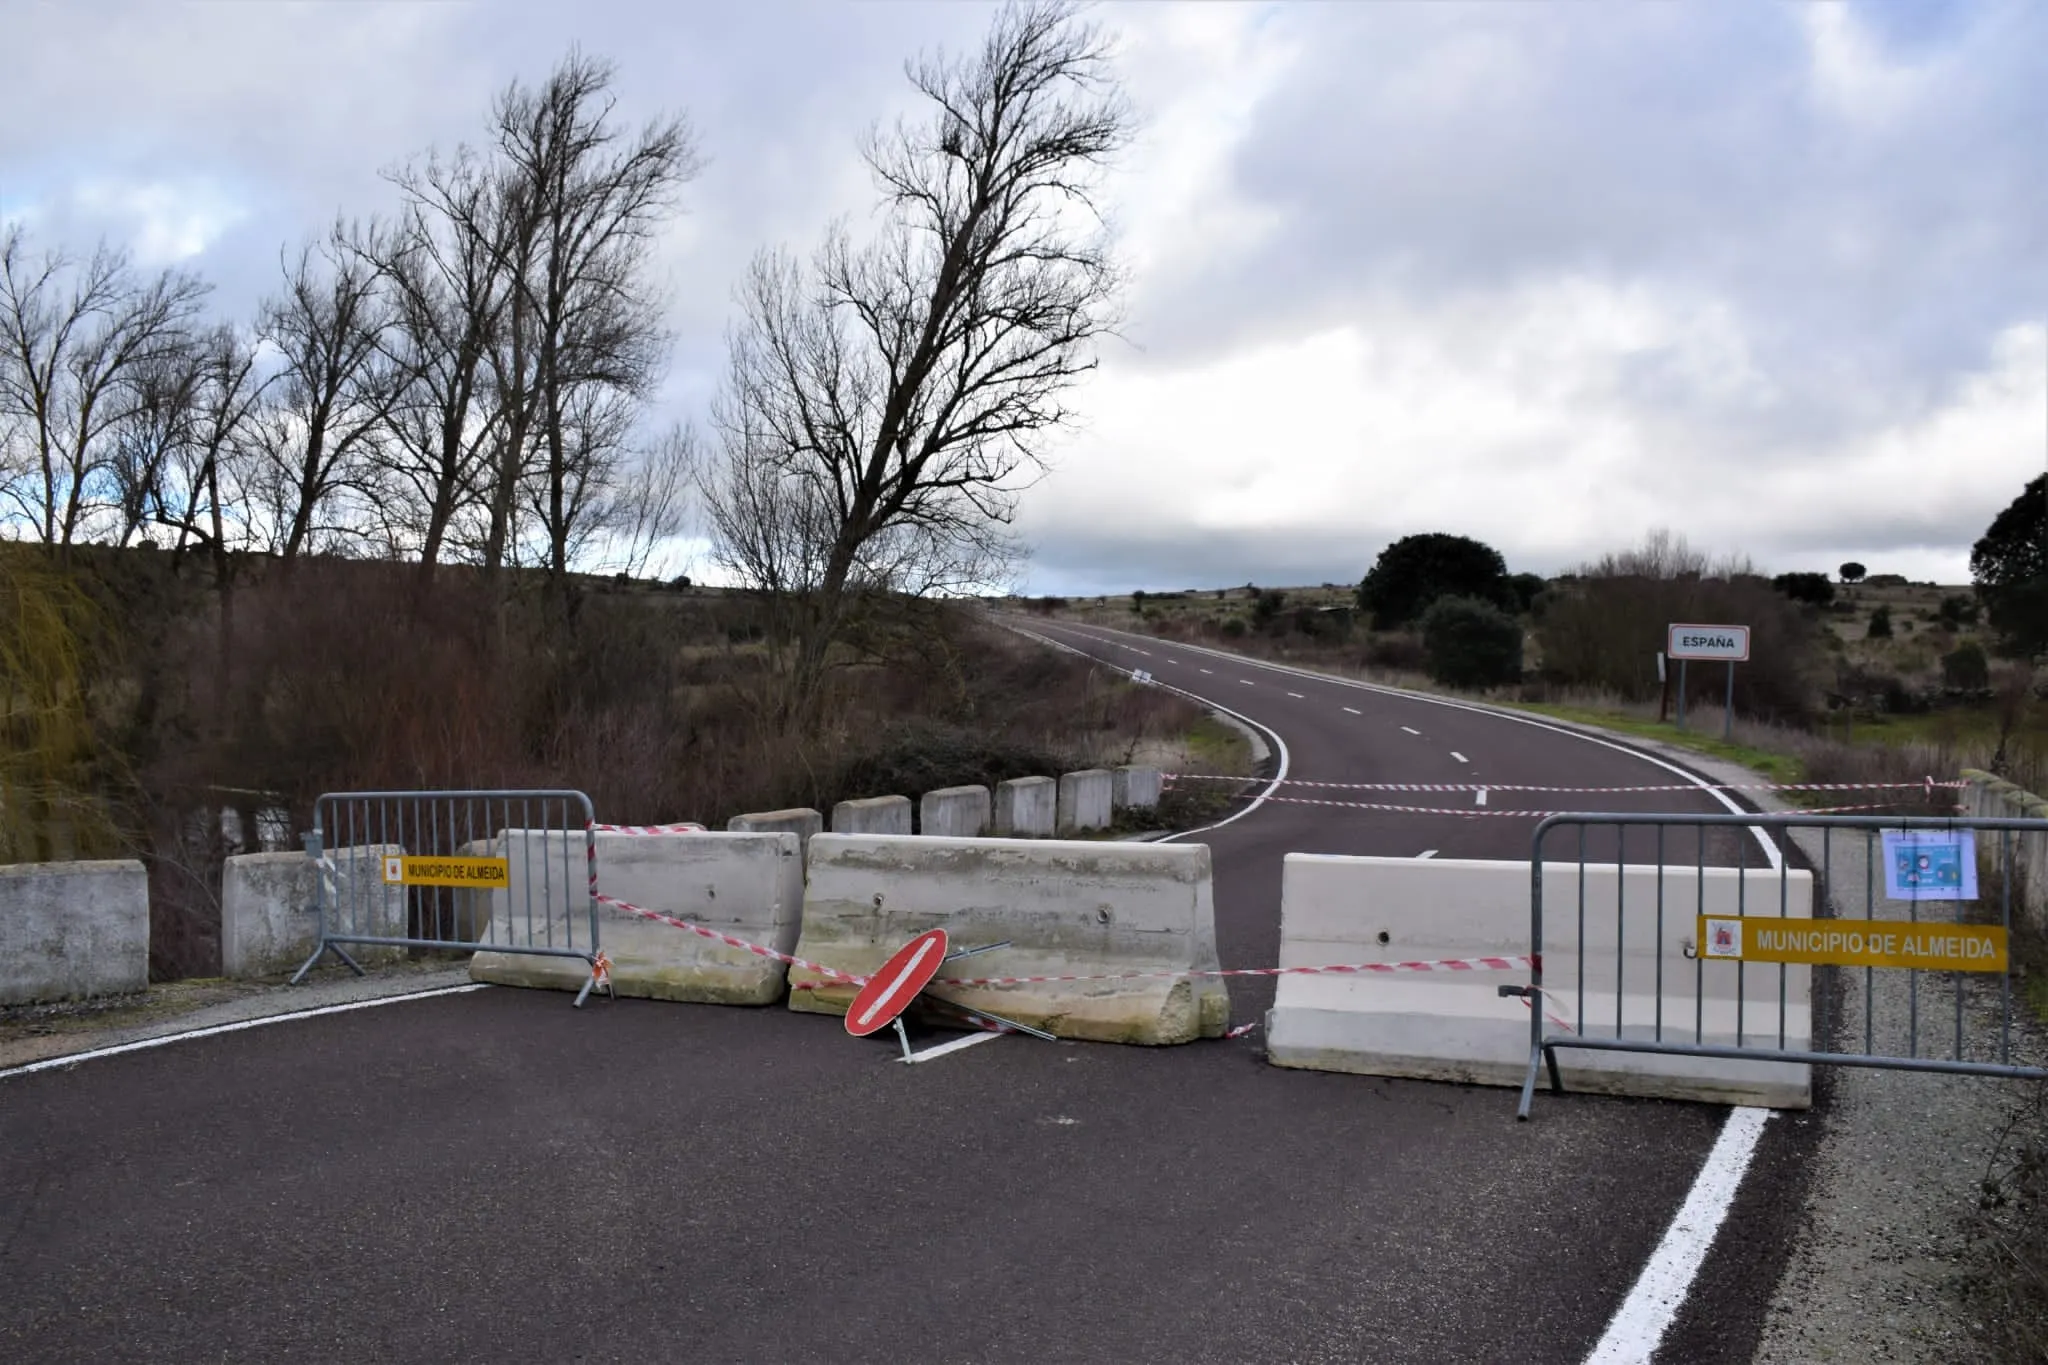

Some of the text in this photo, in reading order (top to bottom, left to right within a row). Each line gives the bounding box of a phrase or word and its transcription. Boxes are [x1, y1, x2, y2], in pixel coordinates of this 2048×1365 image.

[1682, 635, 1735, 648] ESPAÑA
[454, 865, 465, 879] DE
[466, 865, 505, 880] ALMEIDA
[1757, 926, 1997, 959] MUNICÍPIO DE ALMEIDA
